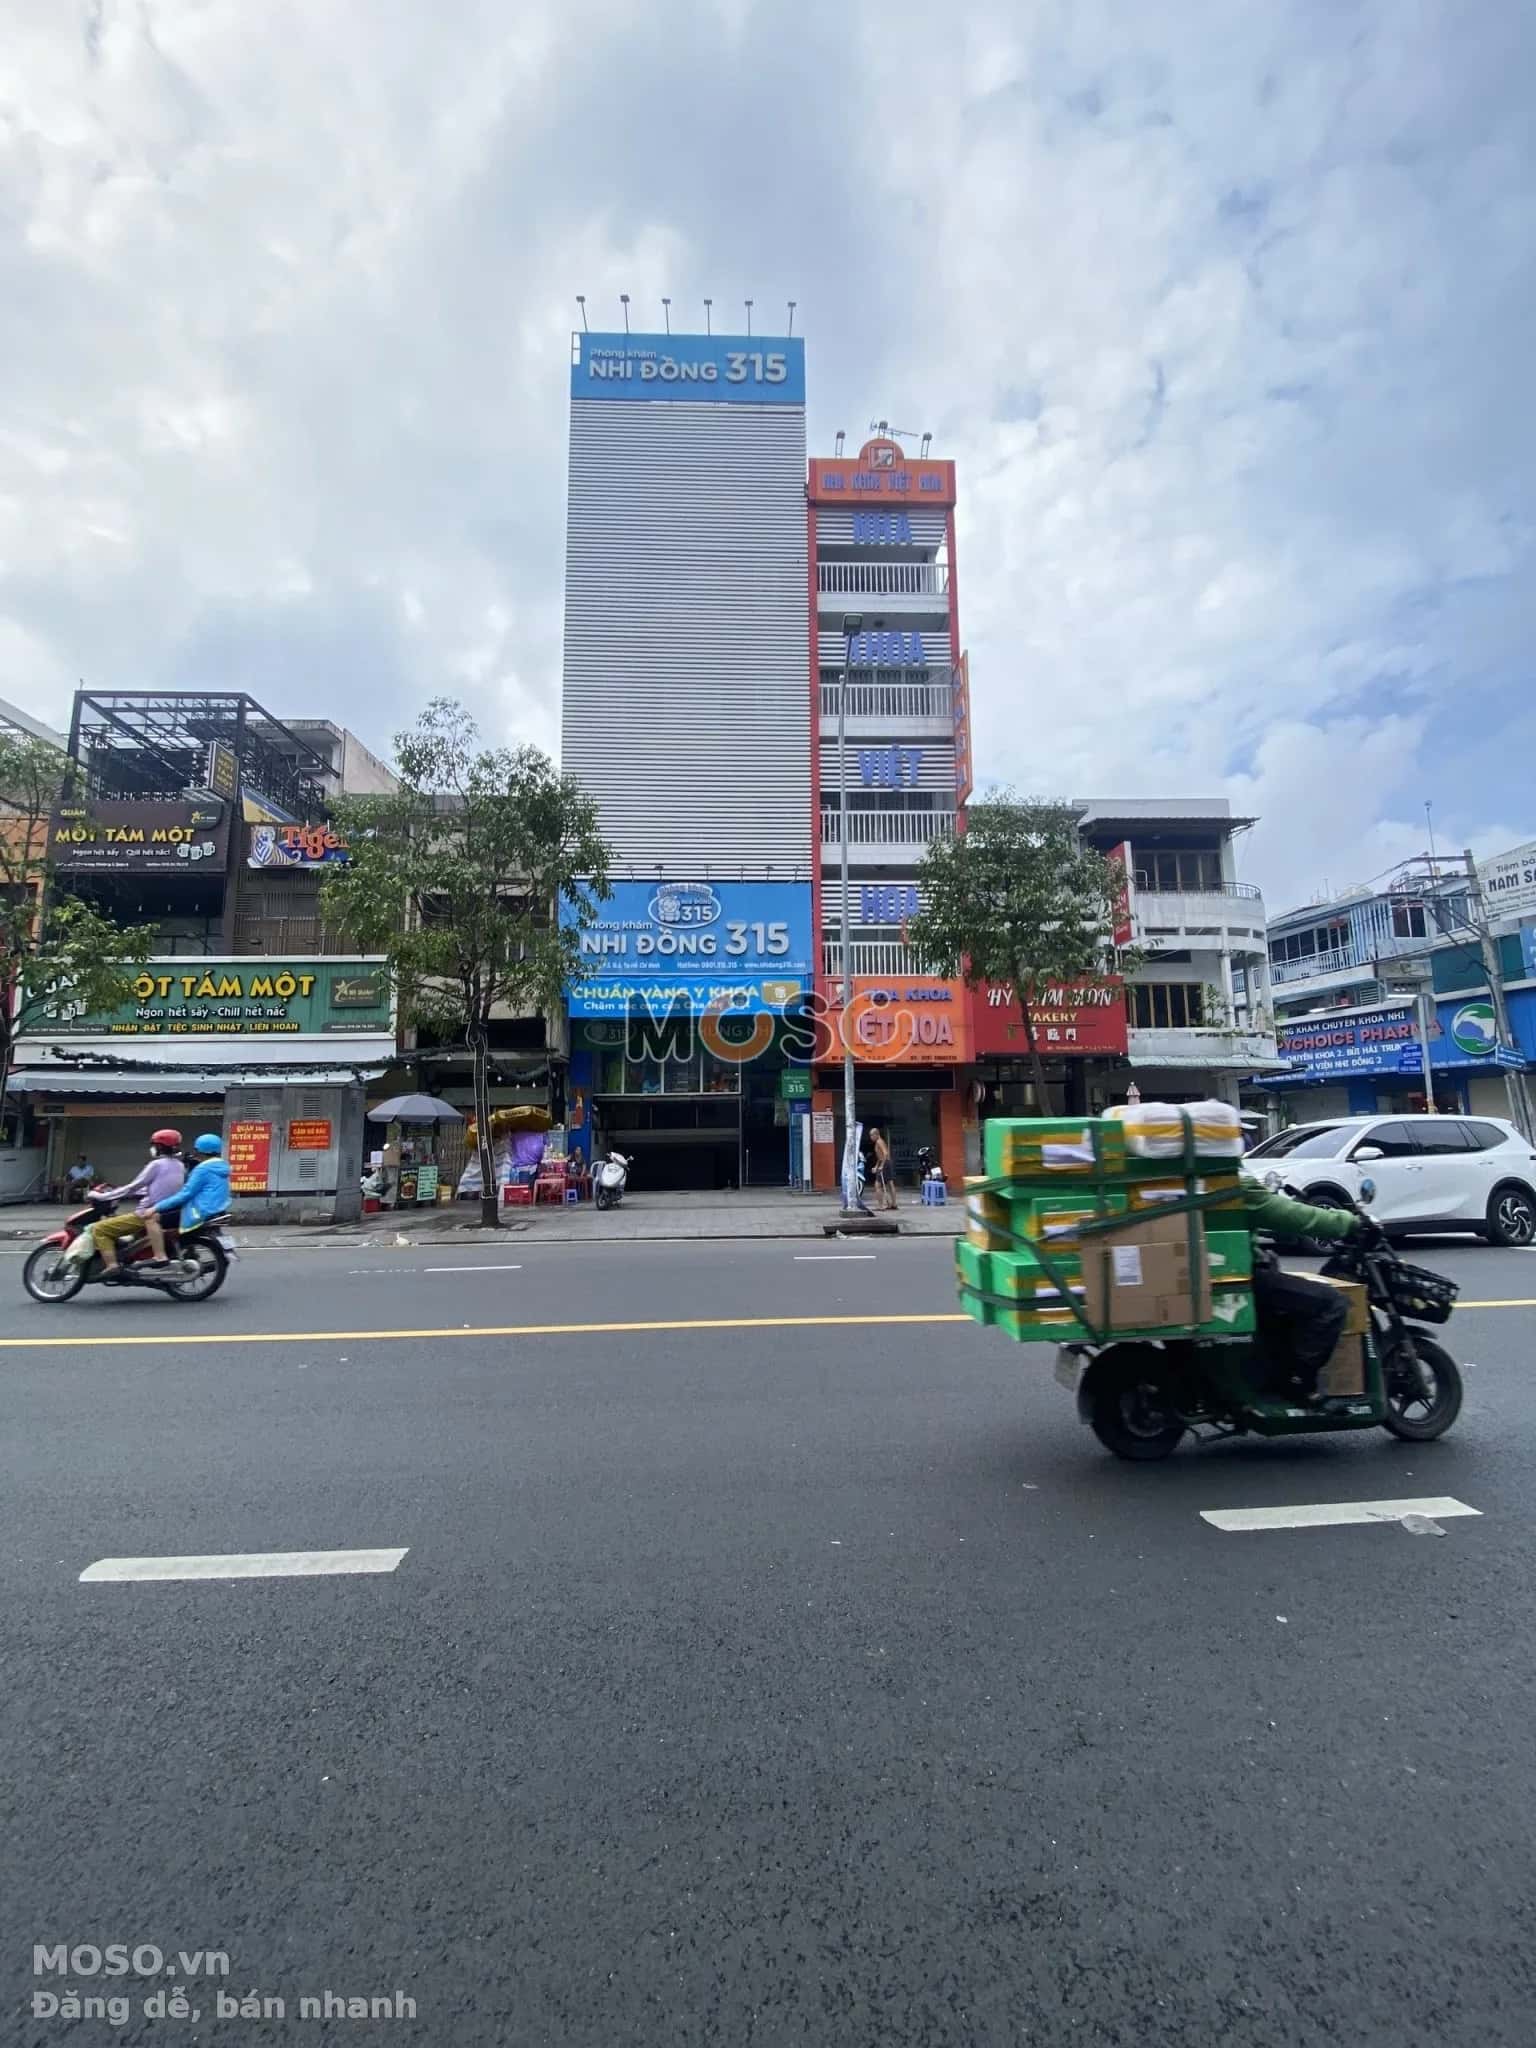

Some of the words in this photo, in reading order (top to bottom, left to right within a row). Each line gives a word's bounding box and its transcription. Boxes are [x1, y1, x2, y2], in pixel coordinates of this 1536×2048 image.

[588, 360, 632, 379] NHI
[639, 356, 718, 381] ĐỒNG
[725, 352, 788, 382] 315
[857, 744, 924, 792] VIỆT
[105, 825, 145, 842] TÁM
[151, 826, 195, 845] MỘT
[1488, 873, 1519, 892] NAM
[681, 905, 713, 921] 315
[860, 886, 919, 923] HOA
[582, 935, 627, 954] NHI
[636, 927, 717, 955] ĐỒNG
[725, 922, 790, 955] 315
[131, 971, 172, 1003] ỘT
[181, 970, 243, 997] TÁM
[250, 971, 316, 1003] MỘT
[906, 989, 953, 1002] KHOA
[135, 1007, 164, 1019] Ngon
[217, 1006, 240, 1017] Chill
[1028, 1012, 1077, 1022] AKERY
[1358, 1014, 1385, 1026] KHOA
[1387, 1010, 1406, 1021] NHI
[191, 1024, 213, 1032] SINH
[788, 1084, 805, 1093] 315
